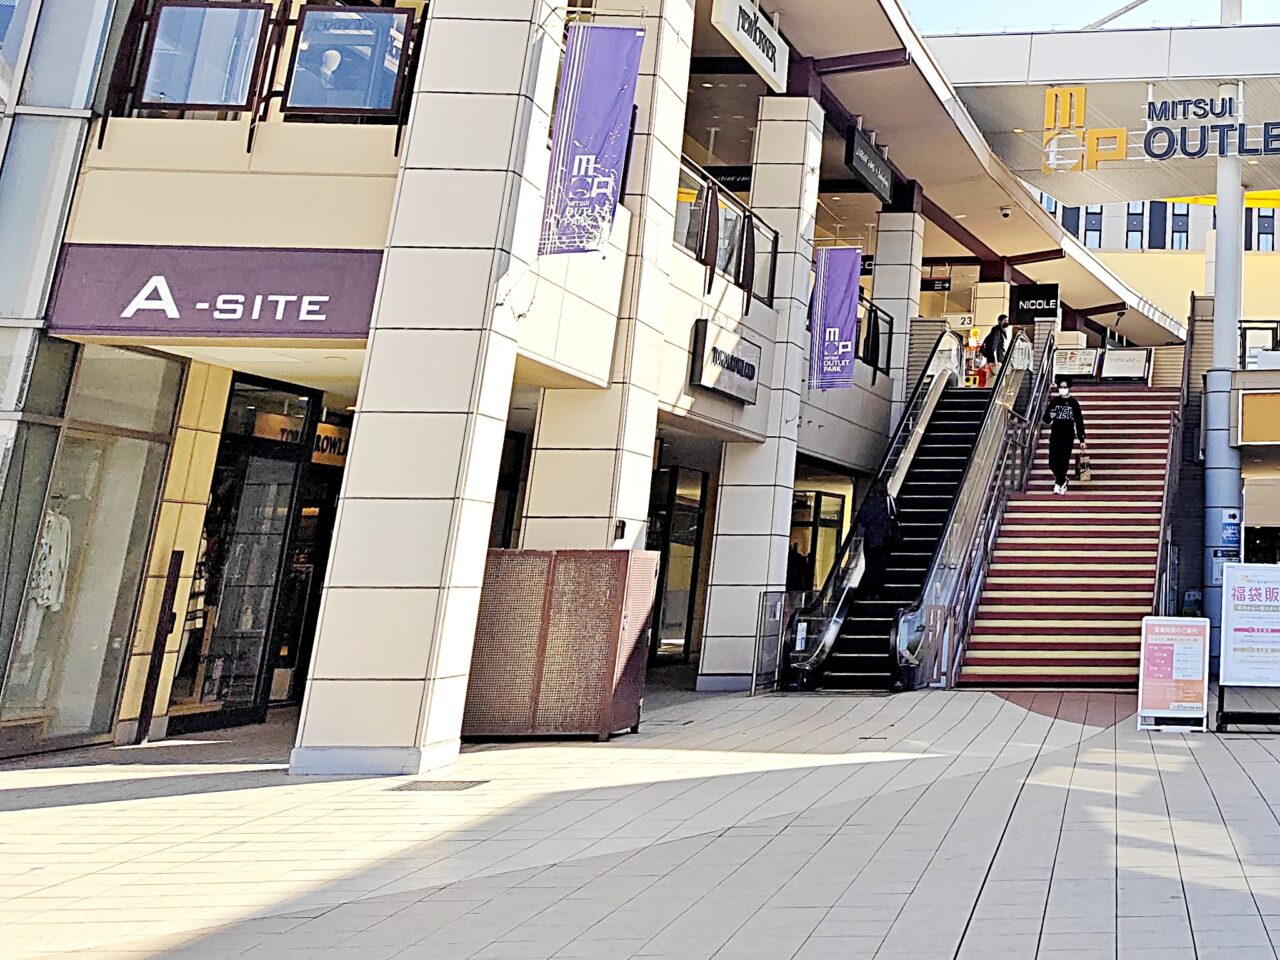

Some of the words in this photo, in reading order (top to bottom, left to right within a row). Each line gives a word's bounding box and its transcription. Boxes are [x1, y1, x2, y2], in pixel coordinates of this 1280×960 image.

[1147, 96, 1235, 121] MITSUI
[1019, 299, 1057, 310] NICOLE
[960, 316, 973, 326] 23
